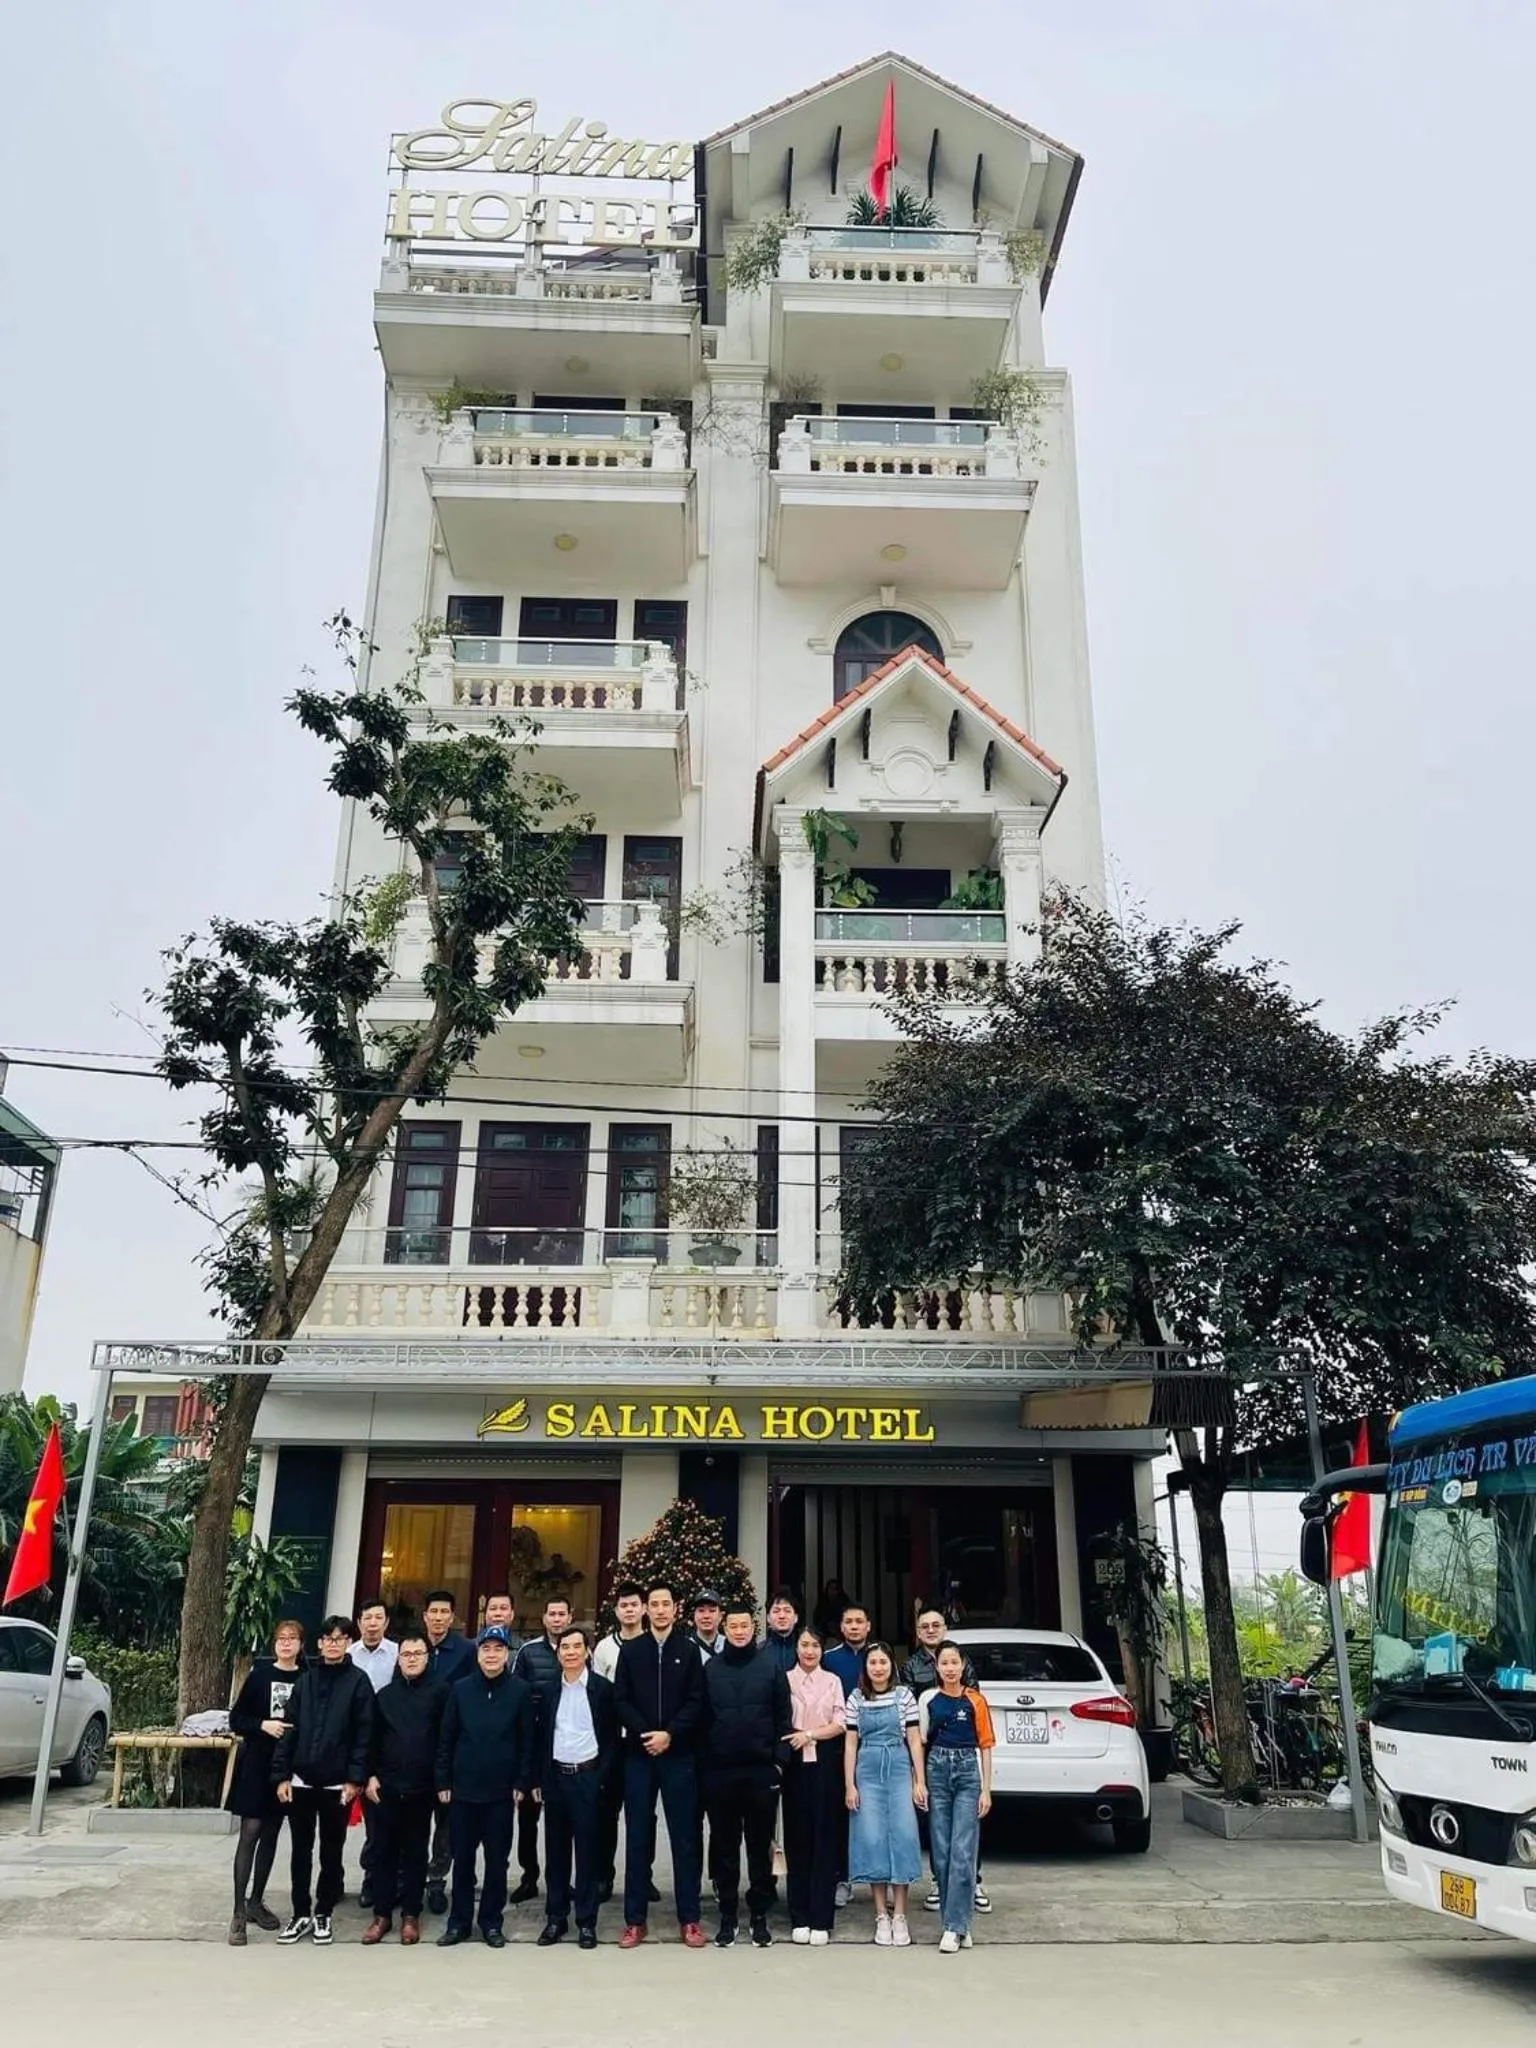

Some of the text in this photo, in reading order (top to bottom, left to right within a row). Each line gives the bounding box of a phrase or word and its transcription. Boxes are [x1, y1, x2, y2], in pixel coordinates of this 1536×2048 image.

[396, 98, 696, 179] Salina
[386, 188, 701, 250] HOTEL
[545, 1402, 936, 1441] SALINA HOTEL
[1018, 1695, 1034, 1704] KIA
[1015, 1712, 1038, 1727] 30E
[1491, 1756, 1527, 1773] TOWN
